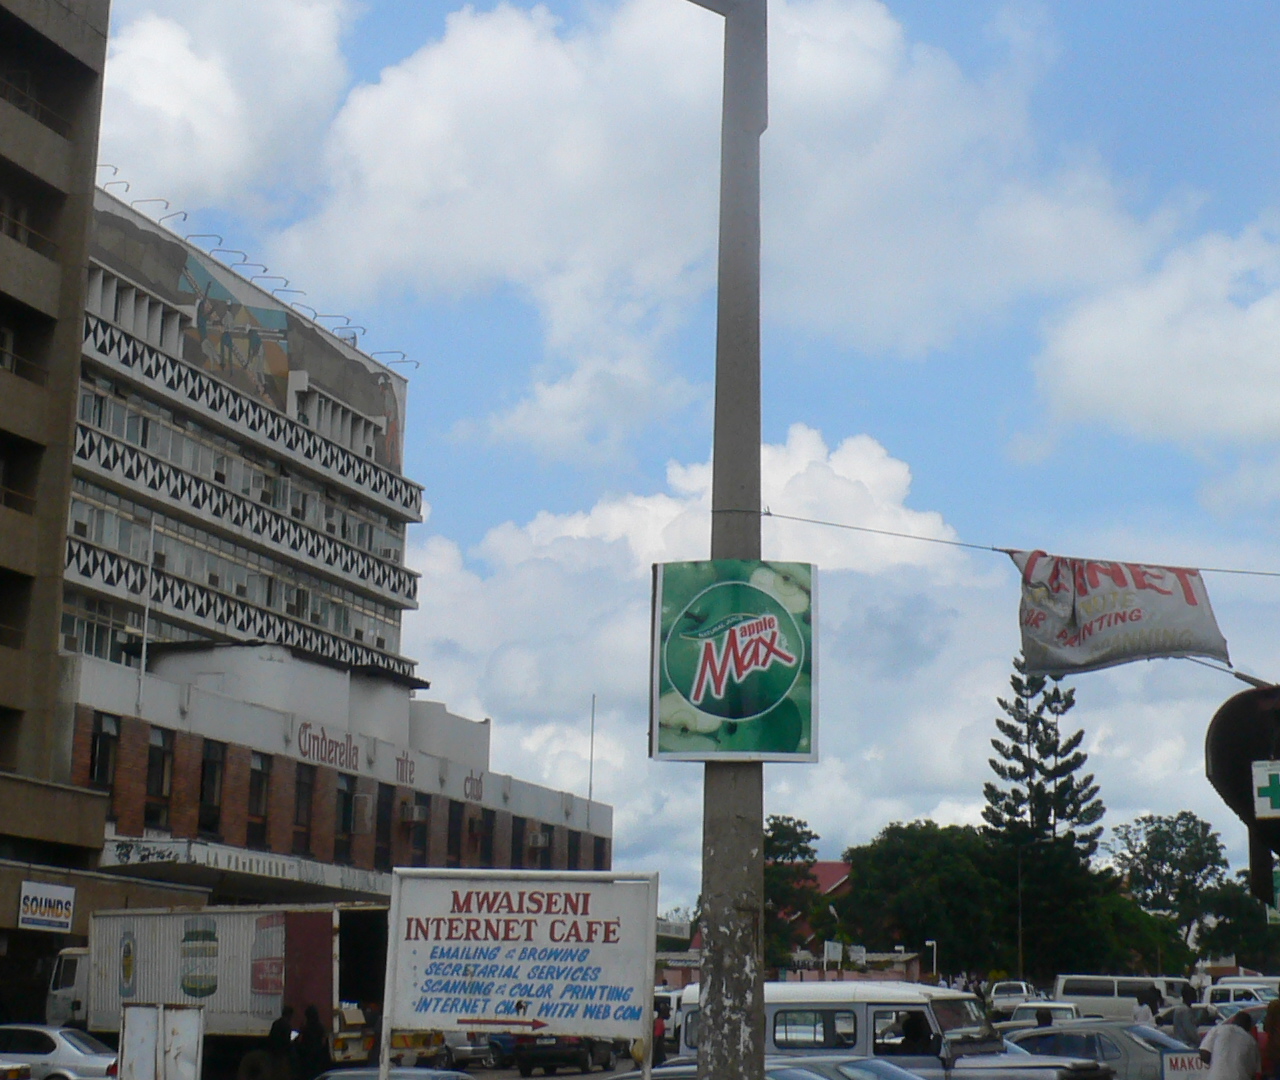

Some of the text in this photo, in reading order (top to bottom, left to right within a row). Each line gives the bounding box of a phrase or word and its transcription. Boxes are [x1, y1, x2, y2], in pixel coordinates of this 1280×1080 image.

[739, 616, 776, 638] apple
[692, 629, 795, 702] Max
[298, 721, 359, 772] Cinderella
[395, 750, 416, 785] nite
[463, 768, 484, 802] club
[22, 895, 72, 919] SOUNDS
[450, 890, 591, 916] MWAISENI
[404, 916, 538, 942] INTERNET
[429, 945, 501, 961] EMAILING
[517, 946, 590, 962] BROWING
[425, 961, 602, 981] SECRETARIAL SERVICES
[421, 978, 495, 996] SCANNING
[509, 983, 554, 999] COLOR
[415, 996, 491, 1014] INTERNET
[537, 1001, 580, 1018] WITH
[582, 1003, 611, 1019] WEB
